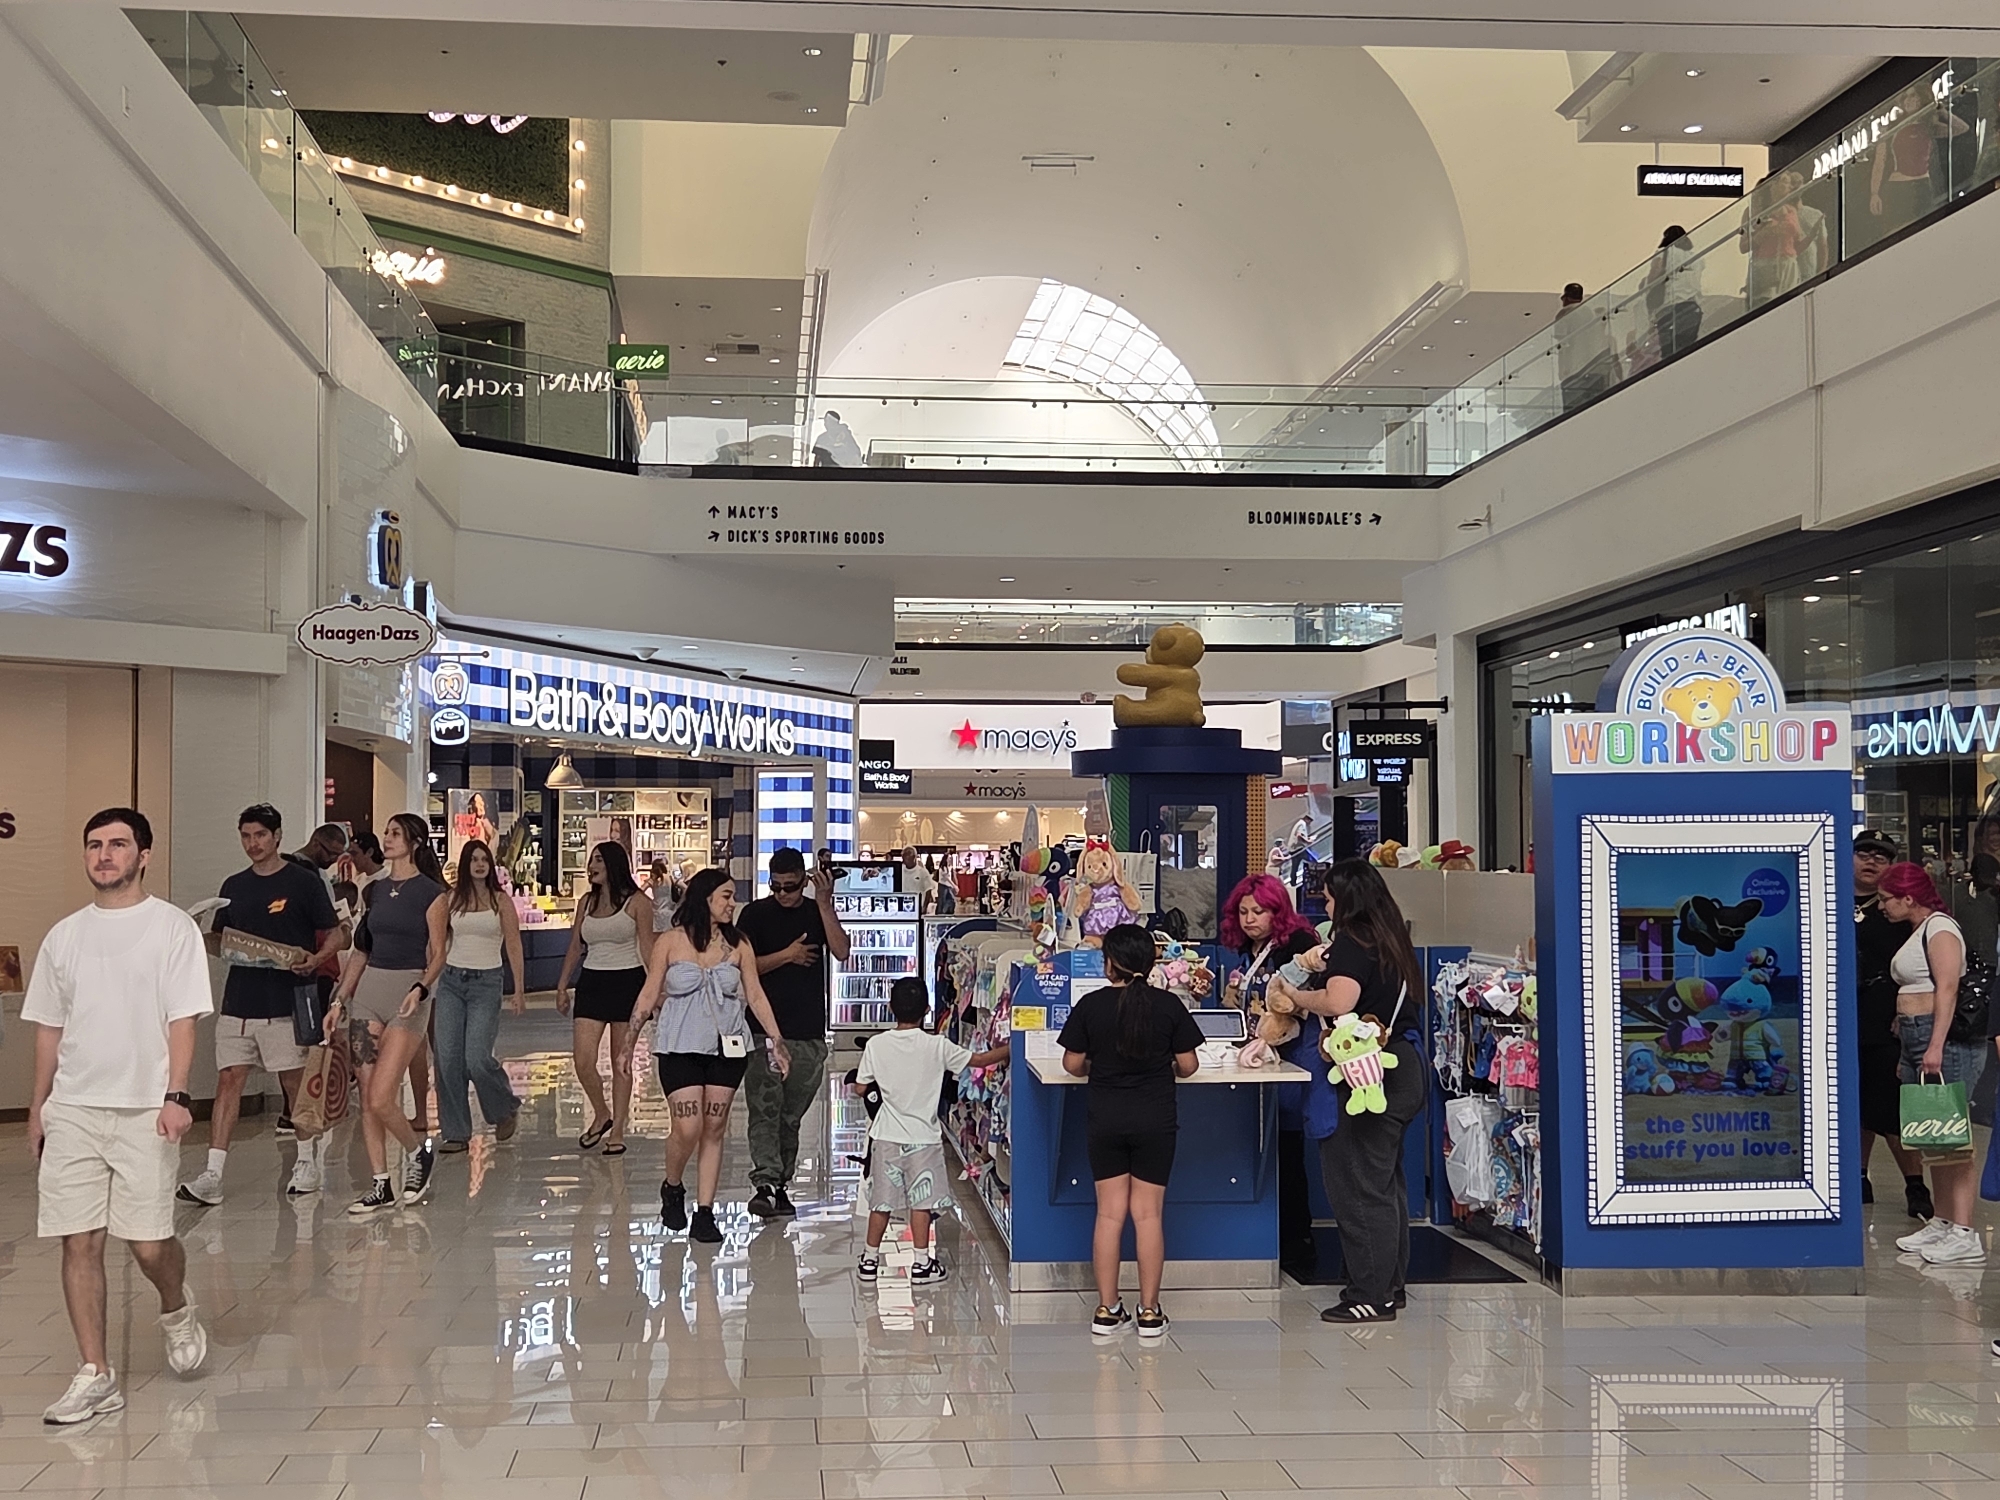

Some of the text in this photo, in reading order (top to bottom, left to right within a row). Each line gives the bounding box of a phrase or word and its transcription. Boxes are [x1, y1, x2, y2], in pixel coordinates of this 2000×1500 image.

[616, 349, 665, 370] aerie
[727, 505, 779, 519] MACY'S
[1248, 511, 1362, 525] BLOOMINGDALE'S
[727, 530, 885, 545] DICK'S SPORTING GOODS
[510, 667, 794, 757] Bath & Body Works
[984, 719, 1077, 755] macy's
[1356, 733, 1422, 746] EXPRESS
[1564, 720, 1838, 765] WORKSHOP
[858, 760, 891, 769] ANGO
[863, 772, 882, 781] Bath
[890, 772, 910, 783] Body
[874, 781, 900, 790] Works
[978, 781, 1026, 800] macy's
[1751, 878, 1781, 888] Online
[1746, 887, 1786, 896] Exclusive
[672, 1100, 698, 1118] 1966
[1645, 1111, 1771, 1134] the SUMMER
[1902, 1112, 1968, 1138] aerie
[1624, 1139, 1687, 1160] stuff
[1692, 1142, 1735, 1163] you
